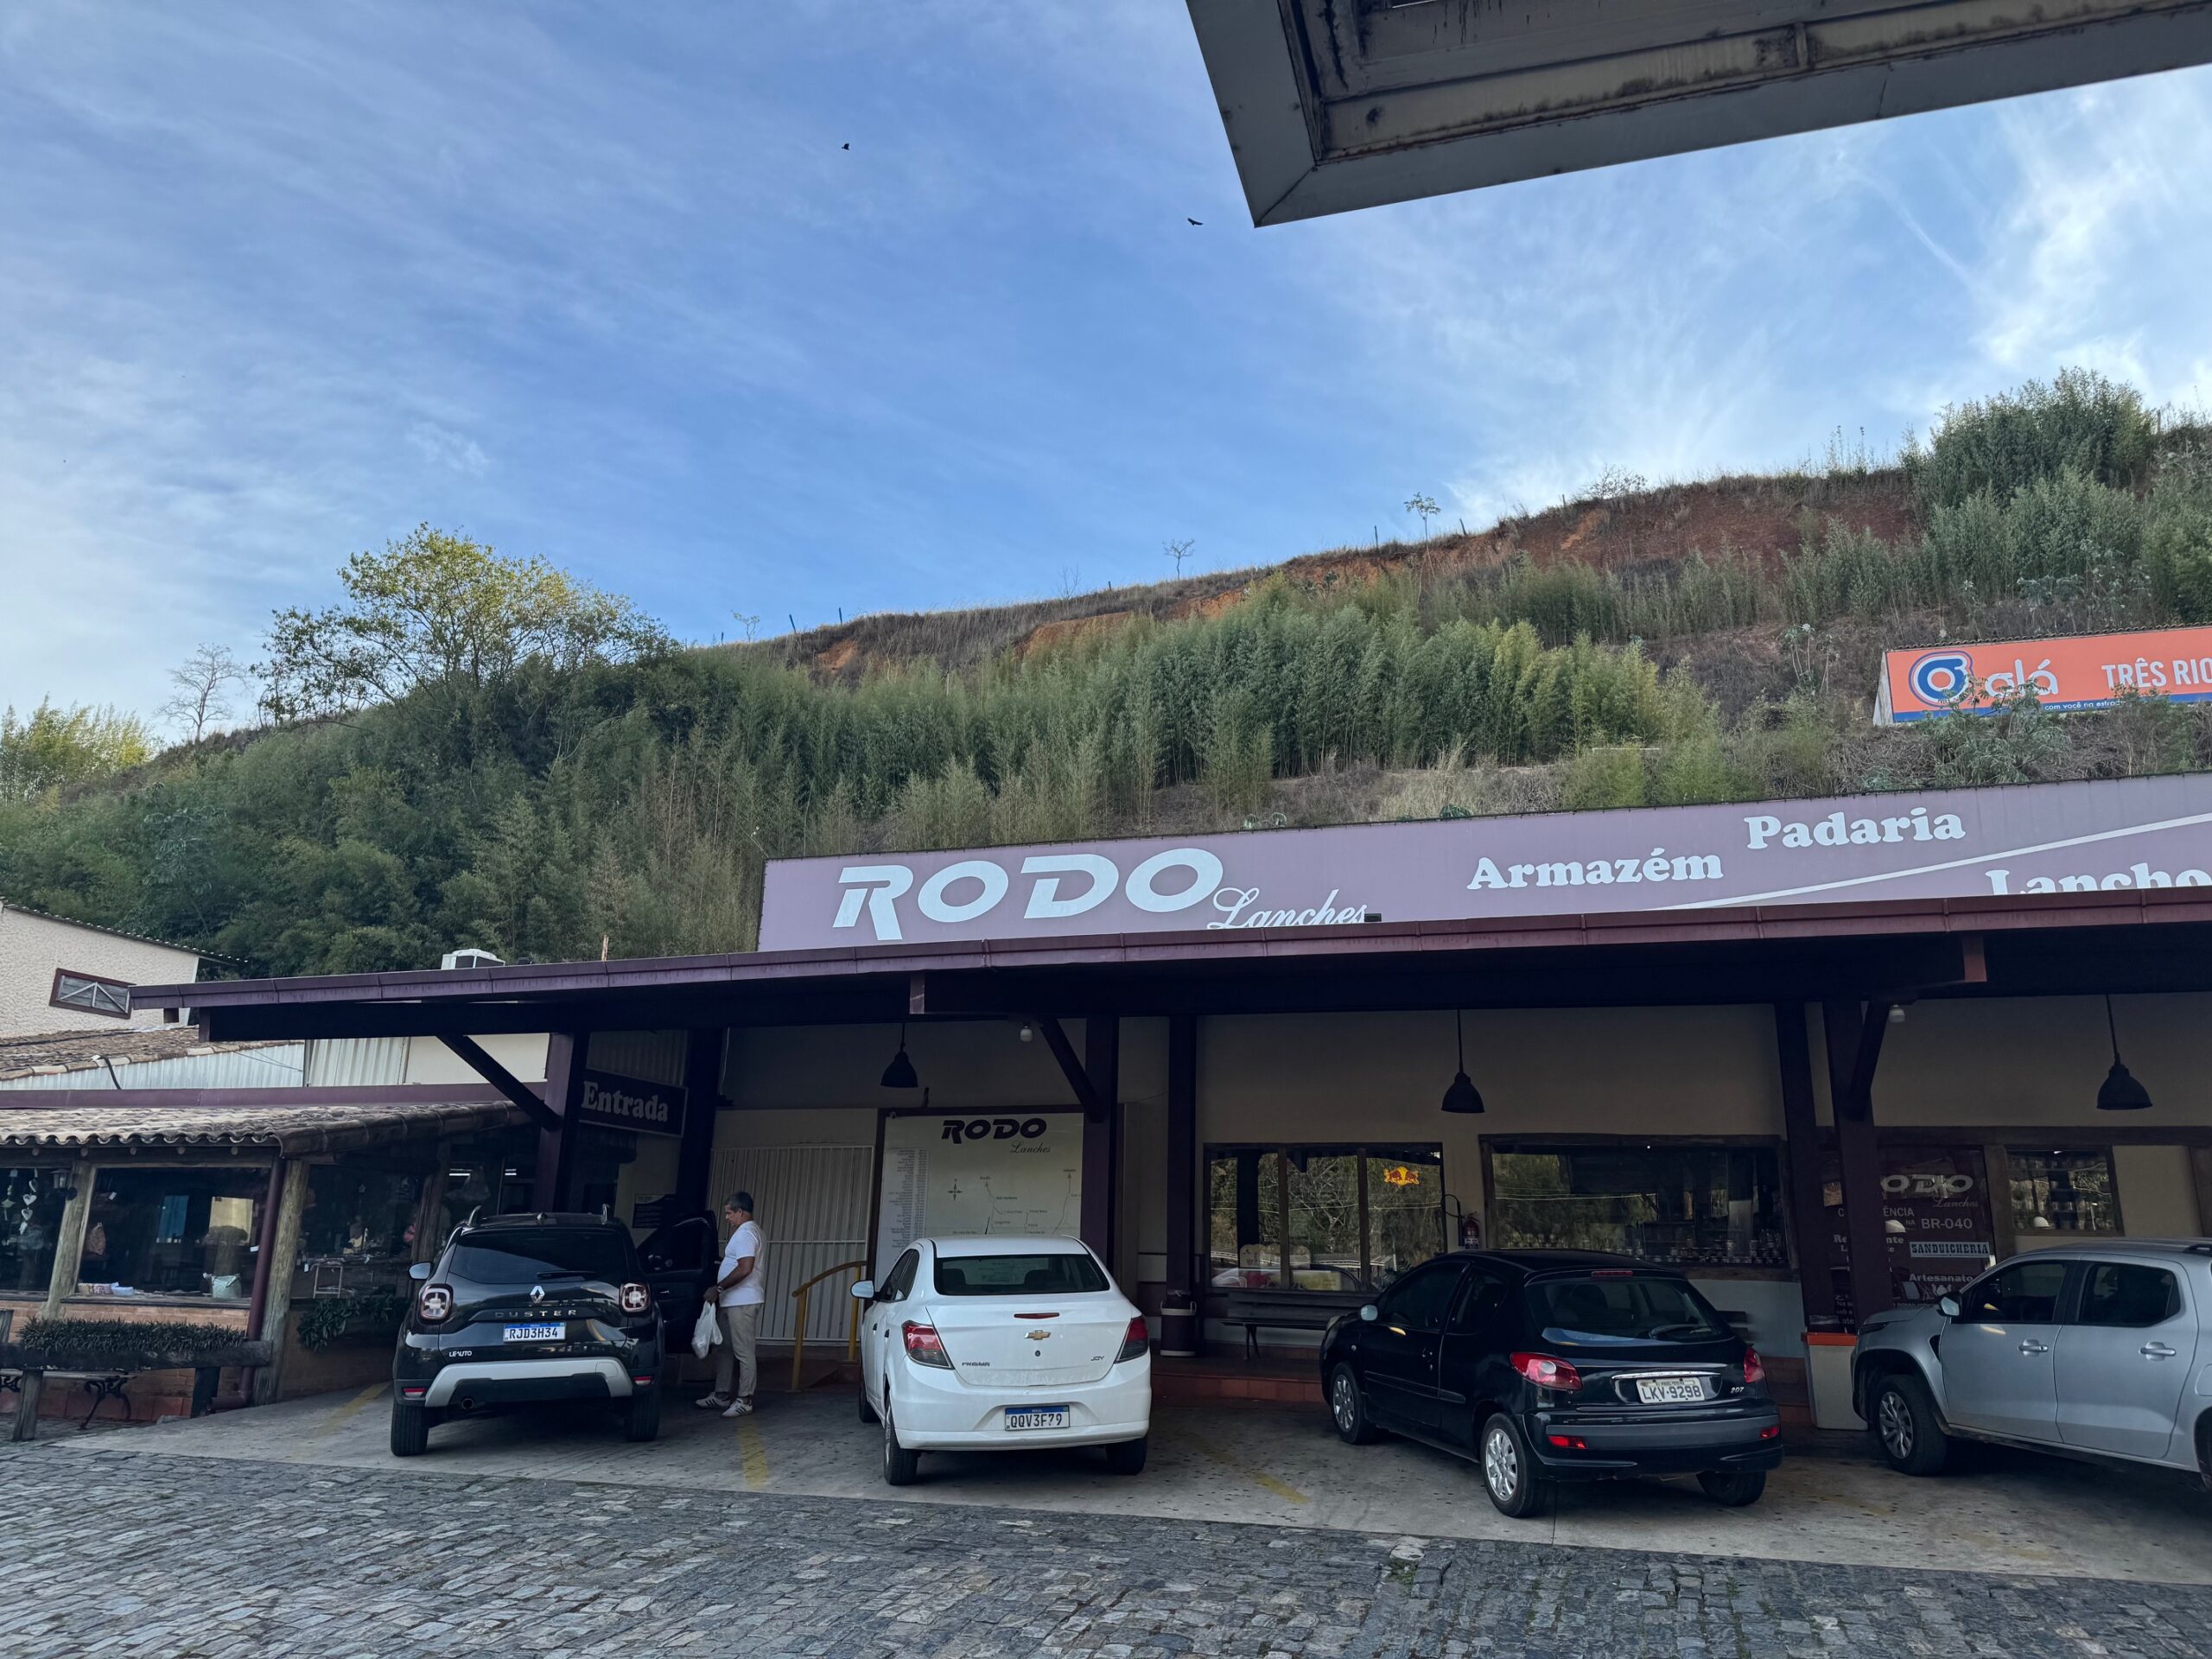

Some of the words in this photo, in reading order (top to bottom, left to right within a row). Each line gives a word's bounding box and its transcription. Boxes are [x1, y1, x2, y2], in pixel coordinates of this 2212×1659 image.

[1984, 658, 2059, 699] alá
[2101, 658, 2167, 689] TRÊS
[1743, 806, 1966, 850] Padaria
[1467, 847, 1724, 890] Armazém
[832, 848, 1224, 941] RODO
[1206, 887, 1368, 930] Lanches
[581, 1080, 669, 1122] Entrada
[941, 1118, 1047, 1144] RODO
[1010, 1141, 1052, 1154] Lanches
[1880, 1173, 1974, 1194] ODO
[1932, 1195, 1979, 1208] Lanches
[1921, 1217, 1973, 1230] BR-040
[1910, 1243, 1988, 1254] SANDUICHERIA
[1909, 1273, 1974, 1283] Artesanato
[494, 1309, 577, 1319] DUSTER
[509, 1327, 558, 1340] RJD3H34
